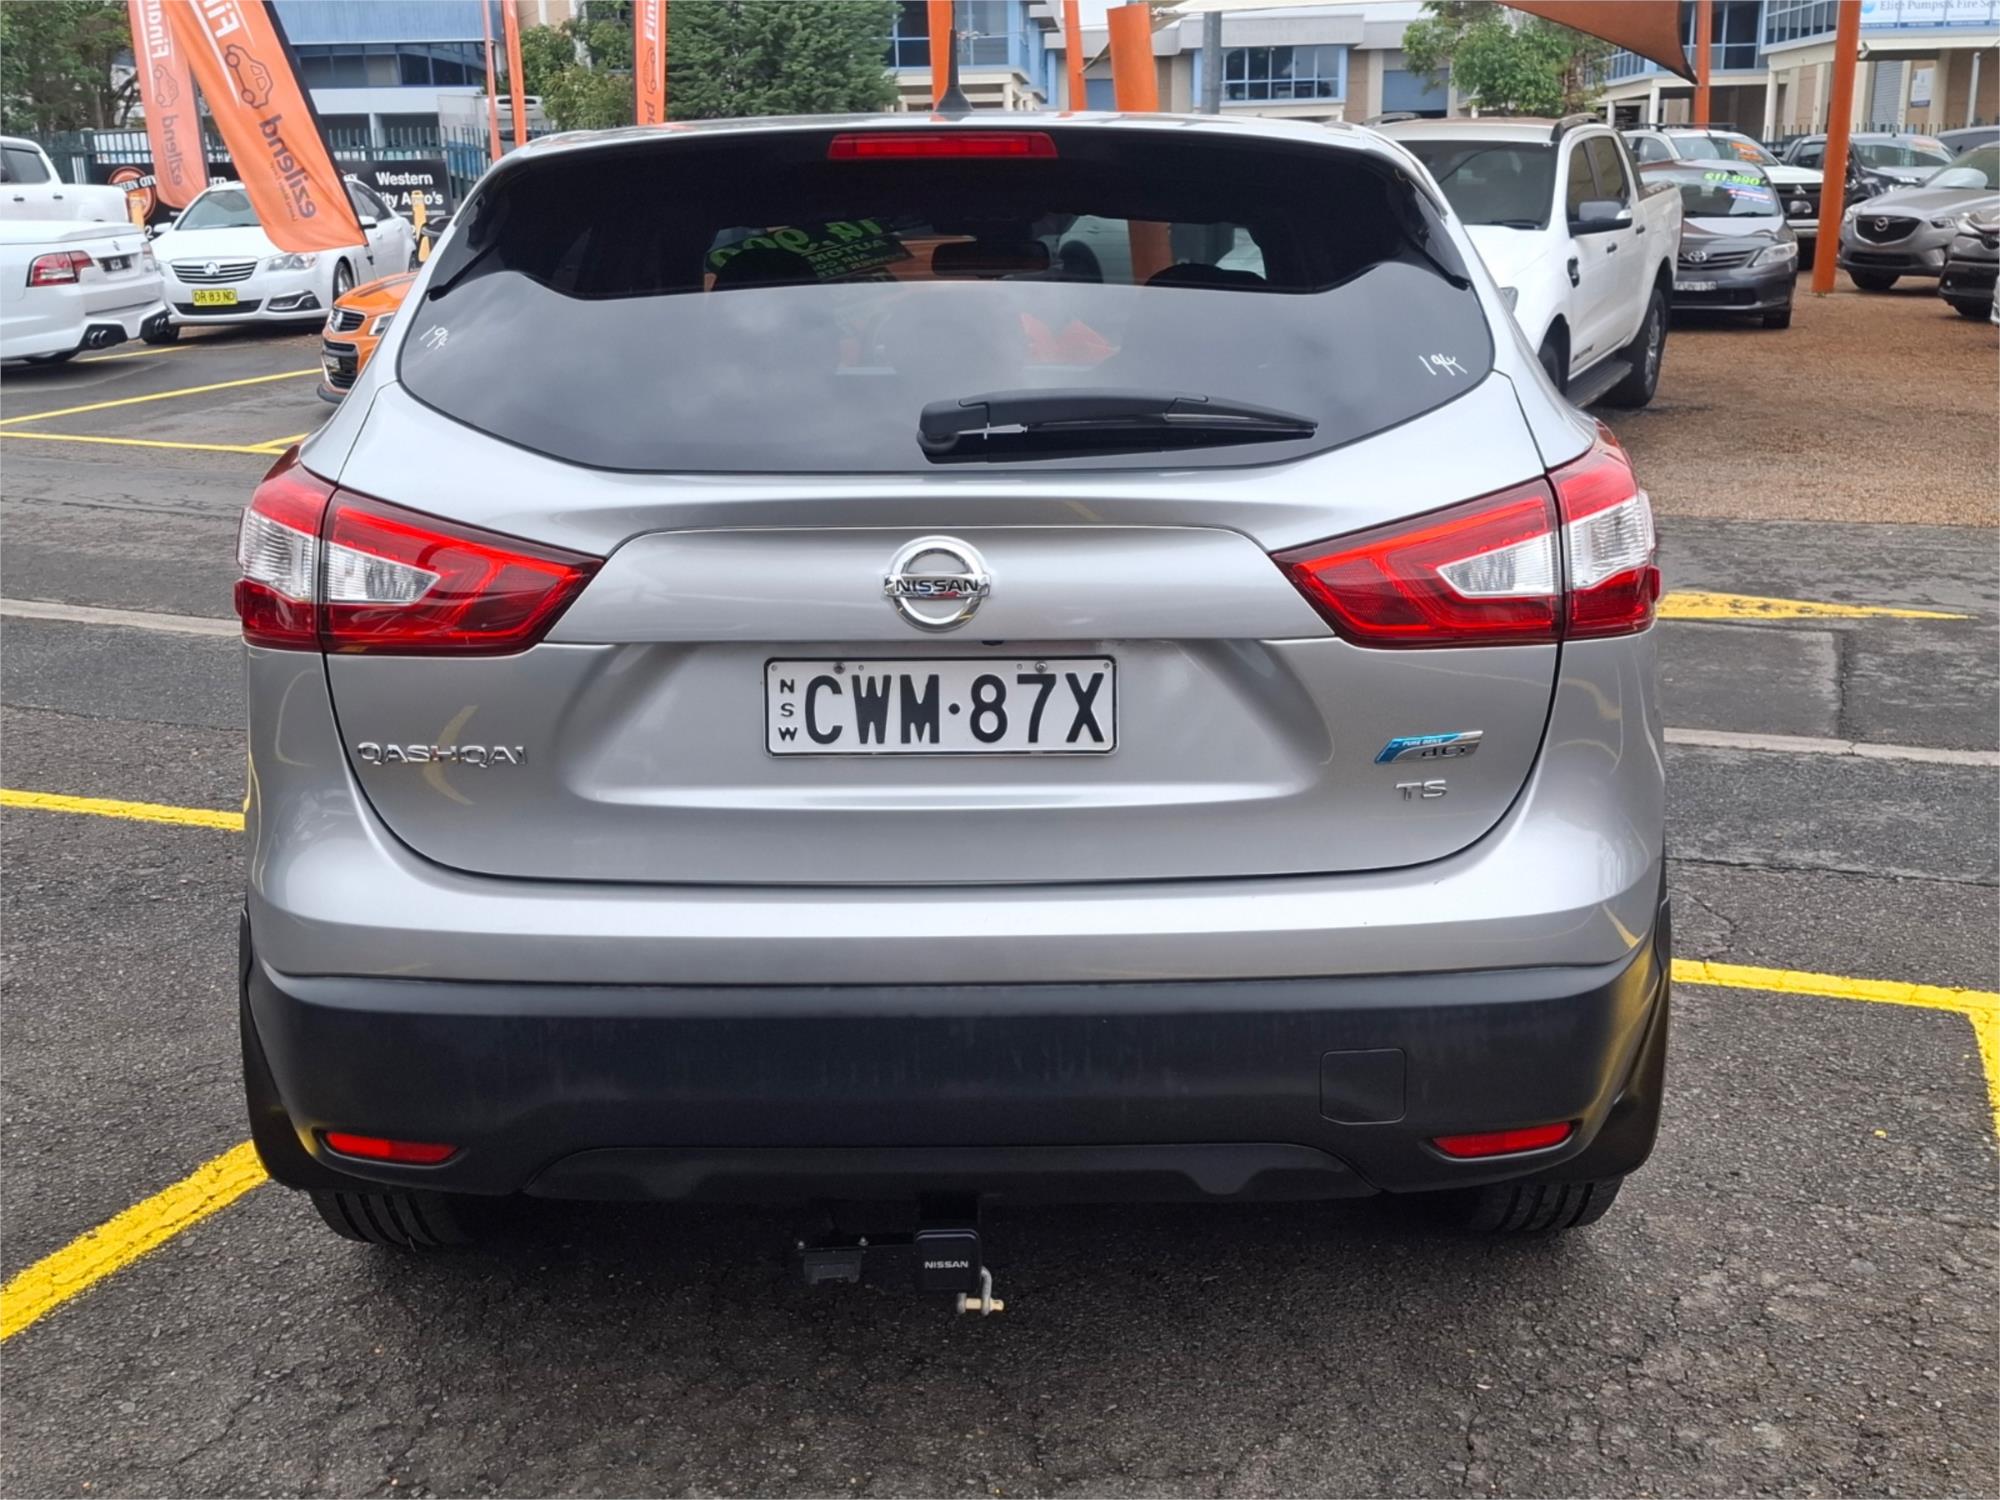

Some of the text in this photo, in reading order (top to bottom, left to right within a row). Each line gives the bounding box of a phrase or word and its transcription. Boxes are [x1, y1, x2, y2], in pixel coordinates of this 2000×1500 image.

[1956, 0, 1977, 9] Fire
[375, 171, 434, 186] Western
[401, 190, 444, 206] Ao's
[895, 579, 979, 592] NISSAN
[358, 742, 528, 768] QASHQAI
[1395, 779, 1448, 800] TS
[924, 1260, 969, 1269] NISSAN
